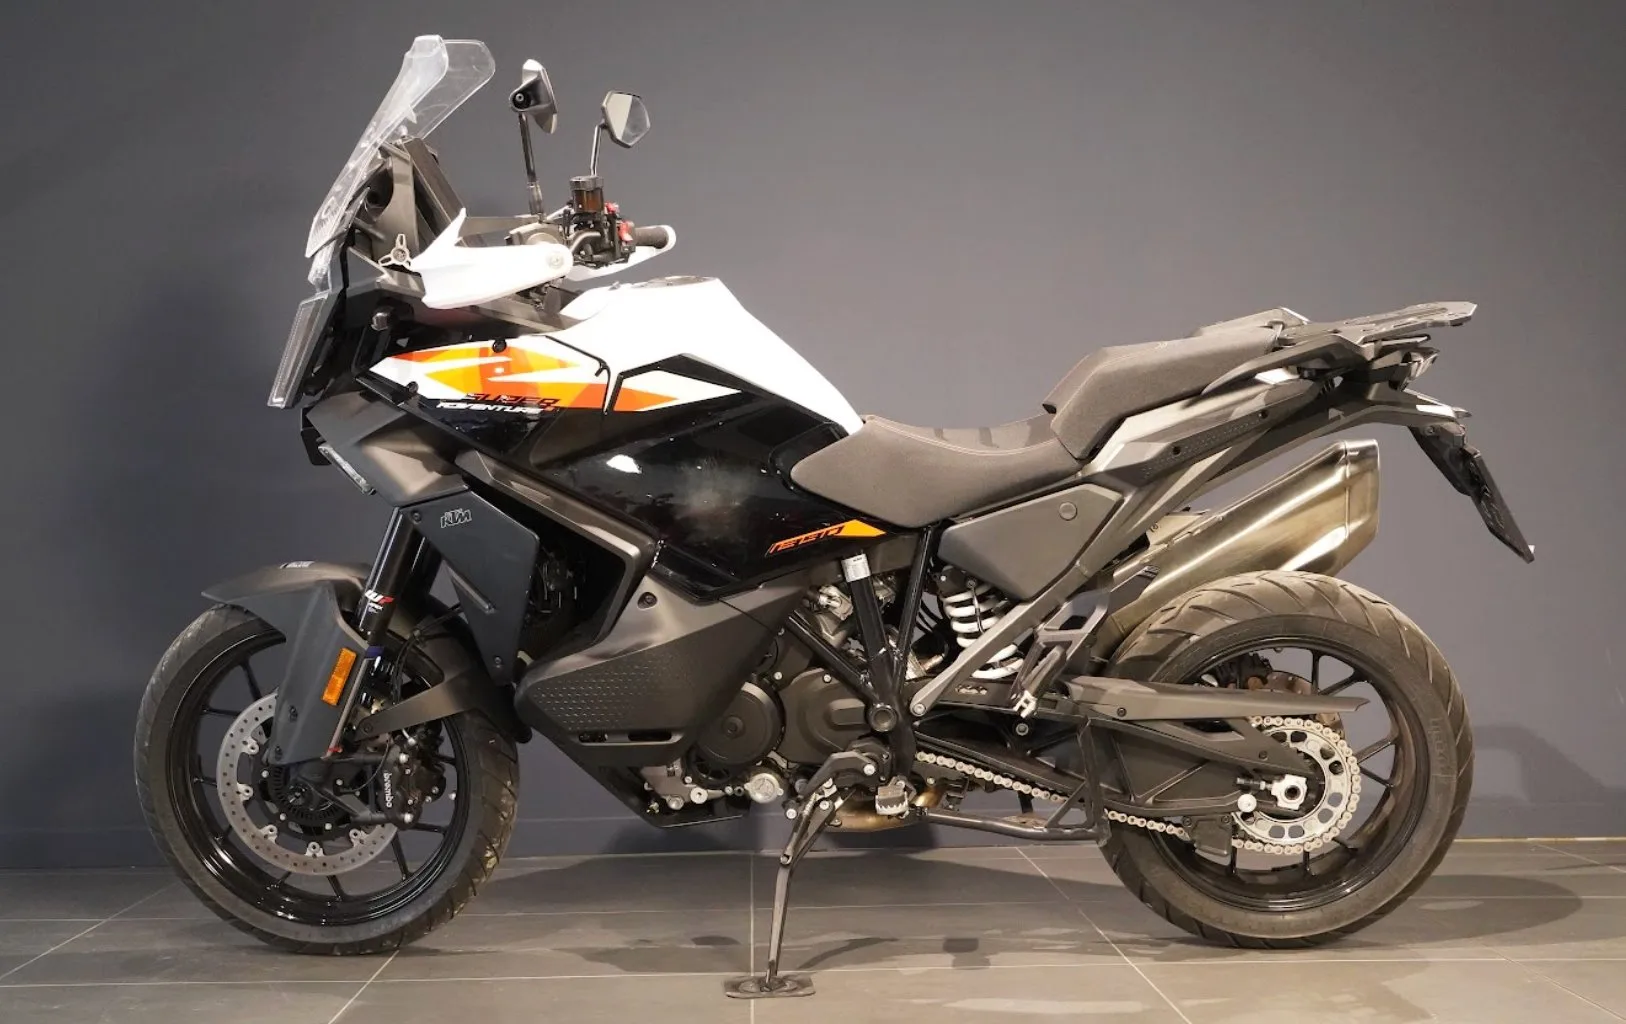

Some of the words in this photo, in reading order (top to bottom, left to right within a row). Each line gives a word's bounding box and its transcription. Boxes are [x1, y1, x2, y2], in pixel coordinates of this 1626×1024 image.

[440, 508, 472, 528] KTM
[365, 589, 394, 604] WP
[383, 772, 394, 808] brembo
